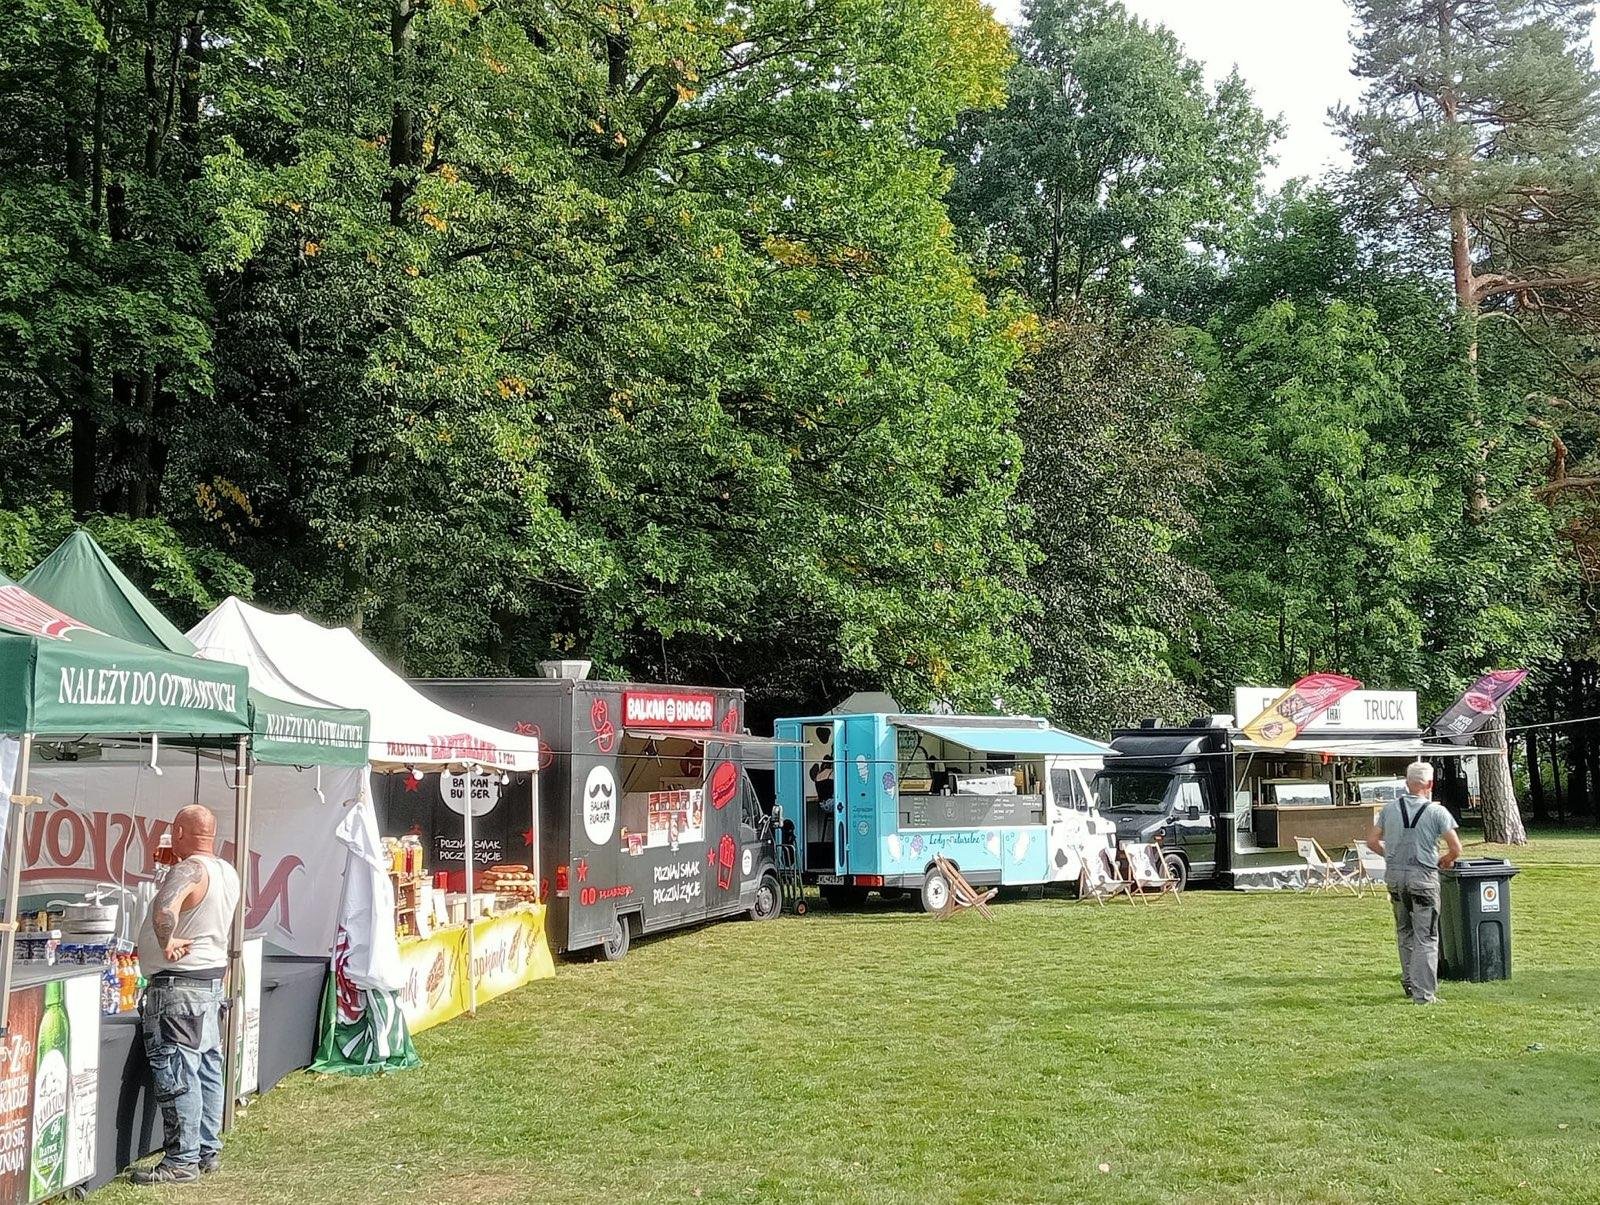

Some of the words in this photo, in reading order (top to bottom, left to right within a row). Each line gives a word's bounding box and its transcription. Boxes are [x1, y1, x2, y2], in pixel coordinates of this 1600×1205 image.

[58, 664, 130, 705] NALEŻY
[131, 671, 156, 705] DO
[159, 672, 237, 713] OTWARTYCH
[627, 697, 665, 721] BALKAN
[676, 699, 713, 722] BURGER
[1364, 699, 1404, 720] TRUCK
[264, 713, 303, 743] NALEŻY
[303, 719, 317, 745] DO
[318, 720, 363, 748] OTWARTYCH
[453, 778, 489, 788] BAKAN
[450, 789, 490, 799] BUGER
[474, 839, 501, 850] SMAK
